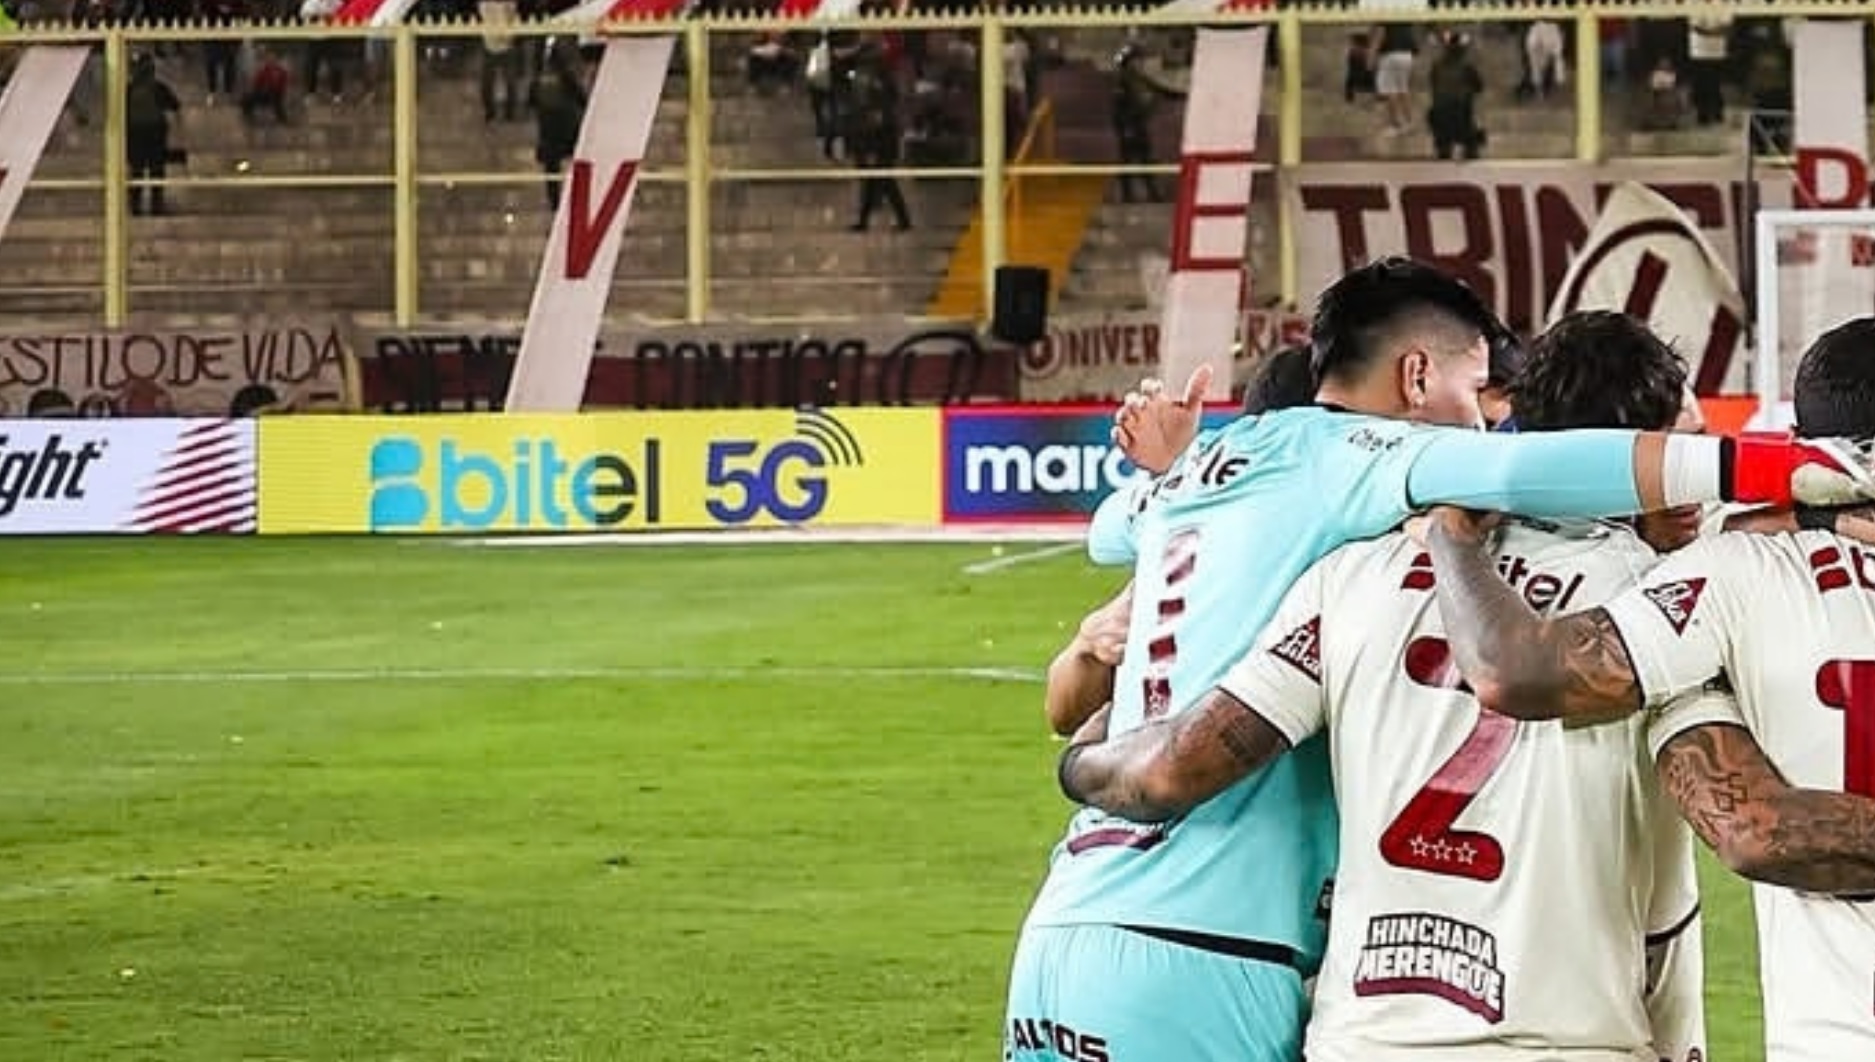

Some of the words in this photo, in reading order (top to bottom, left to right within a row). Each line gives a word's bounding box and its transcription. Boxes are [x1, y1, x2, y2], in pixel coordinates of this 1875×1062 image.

[566, 160, 639, 279] V
[162, 335, 234, 386] DE
[241, 324, 346, 386] VIDA
[441, 439, 661, 527] bitel
[705, 441, 828, 524] 5G
[1379, 635, 1519, 883] 2
[1356, 946, 1504, 1012] MERENGUE
[1371, 915, 1495, 968] HINCHADA
